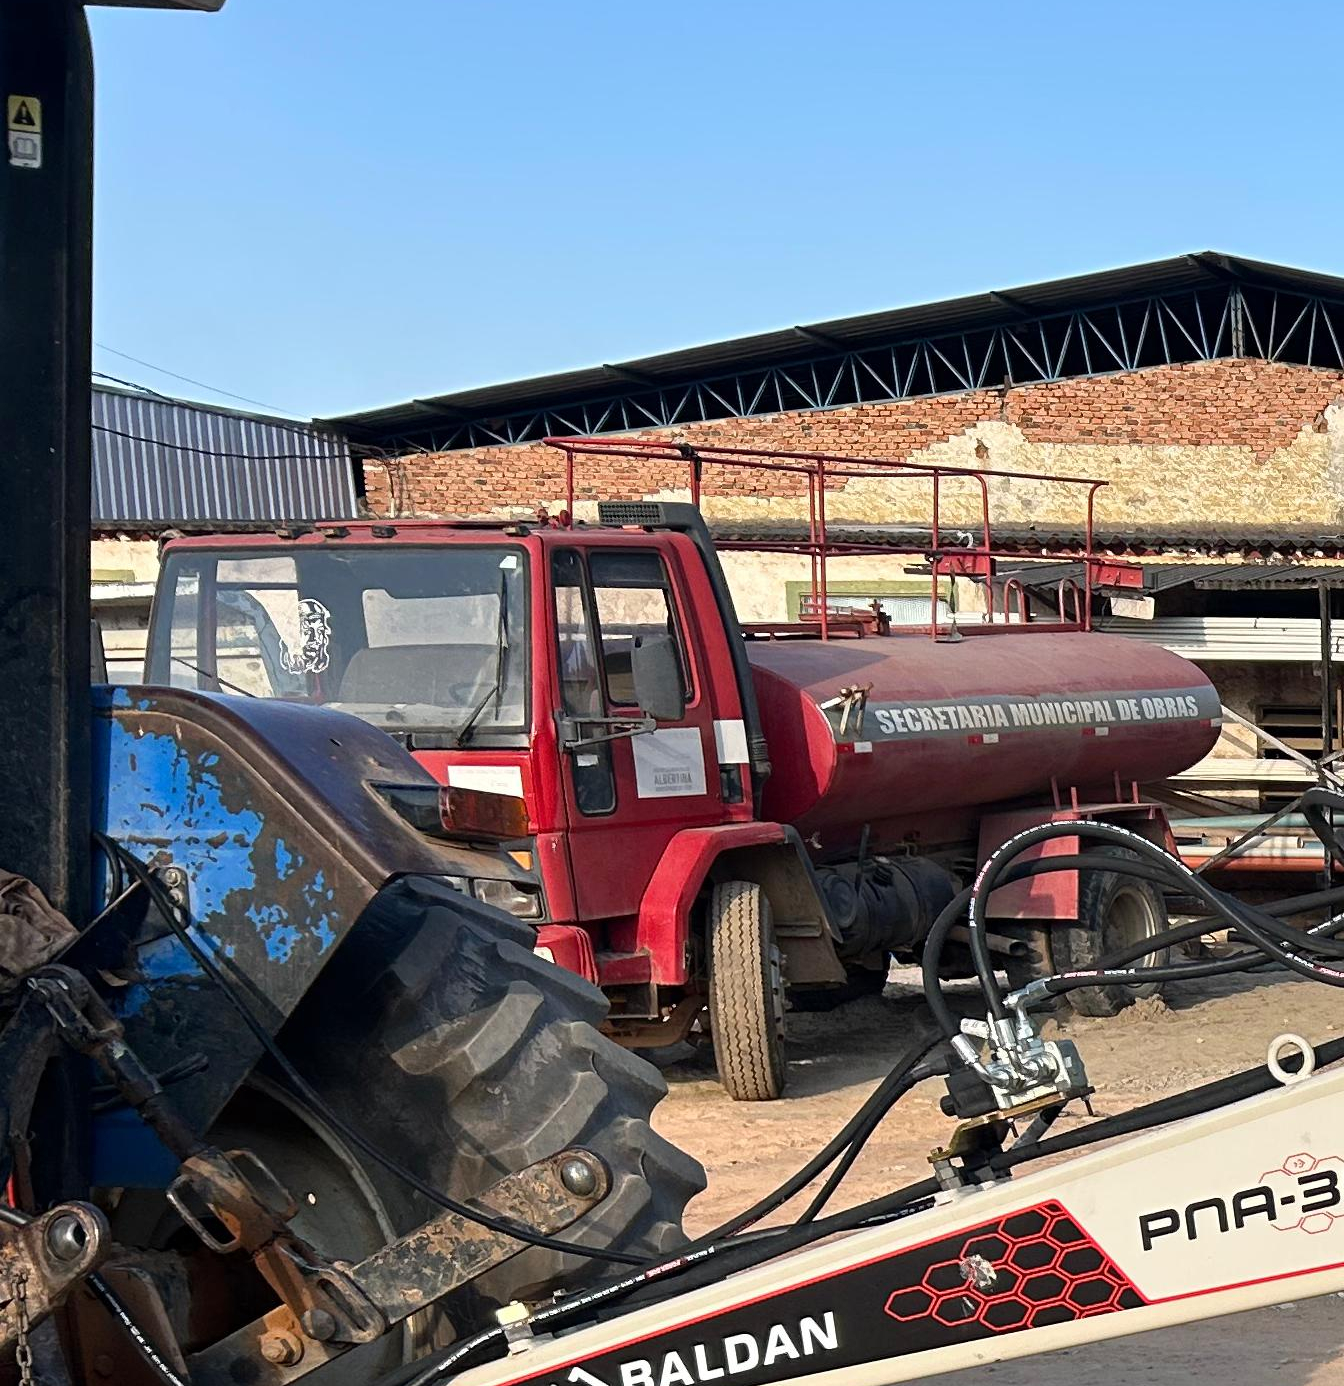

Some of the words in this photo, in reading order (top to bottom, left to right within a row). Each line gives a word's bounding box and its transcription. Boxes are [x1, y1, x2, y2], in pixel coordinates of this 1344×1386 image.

[874, 703, 1009, 734] SECRETARIA
[1010, 699, 1116, 727] MUNICIPAL
[1118, 698, 1143, 721] DE
[1142, 696, 1199, 719] OBRAS
